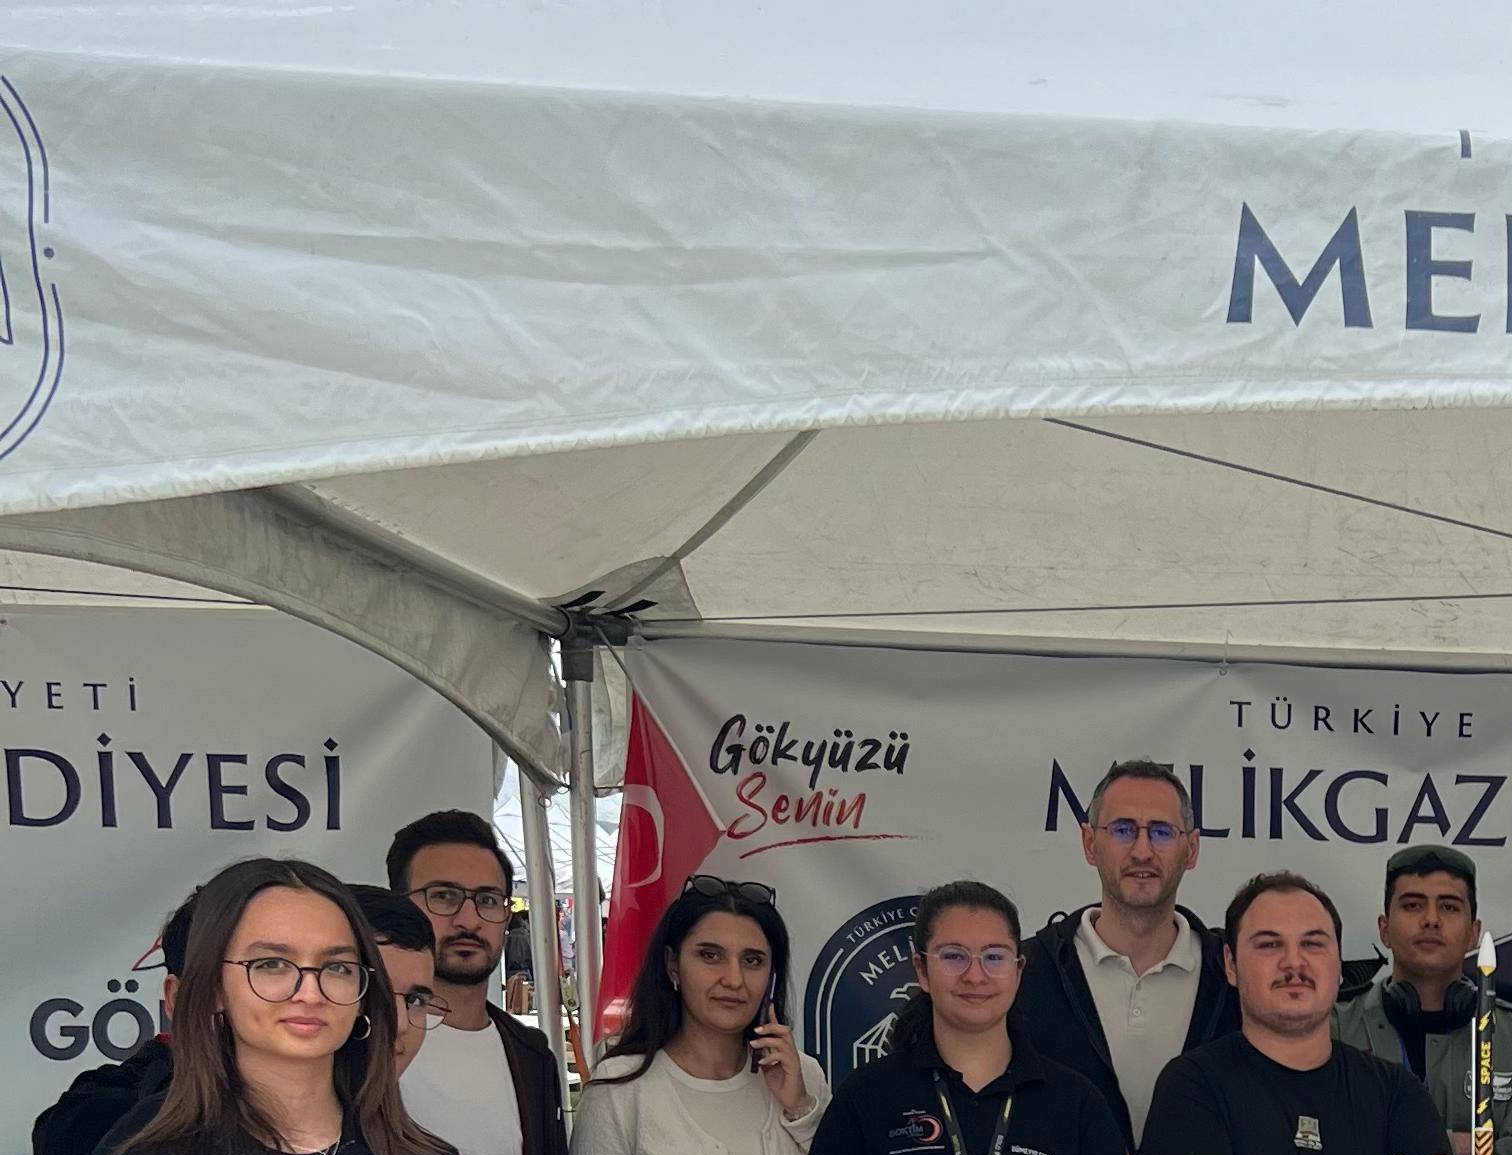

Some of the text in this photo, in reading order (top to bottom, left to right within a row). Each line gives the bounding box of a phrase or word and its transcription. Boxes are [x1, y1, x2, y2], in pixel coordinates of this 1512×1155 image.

[1, 677, 137, 711] YETİ
[1230, 696, 1474, 739] TÜRKİYE
[709, 713, 912, 789] Gökyüzü
[4, 732, 342, 831] DİYESİ
[725, 772, 867, 839] Senin
[846, 907, 905, 944] TÜRKİYE
[859, 935, 916, 985] MELİ
[1480, 1040, 1491, 1085] SPACE
